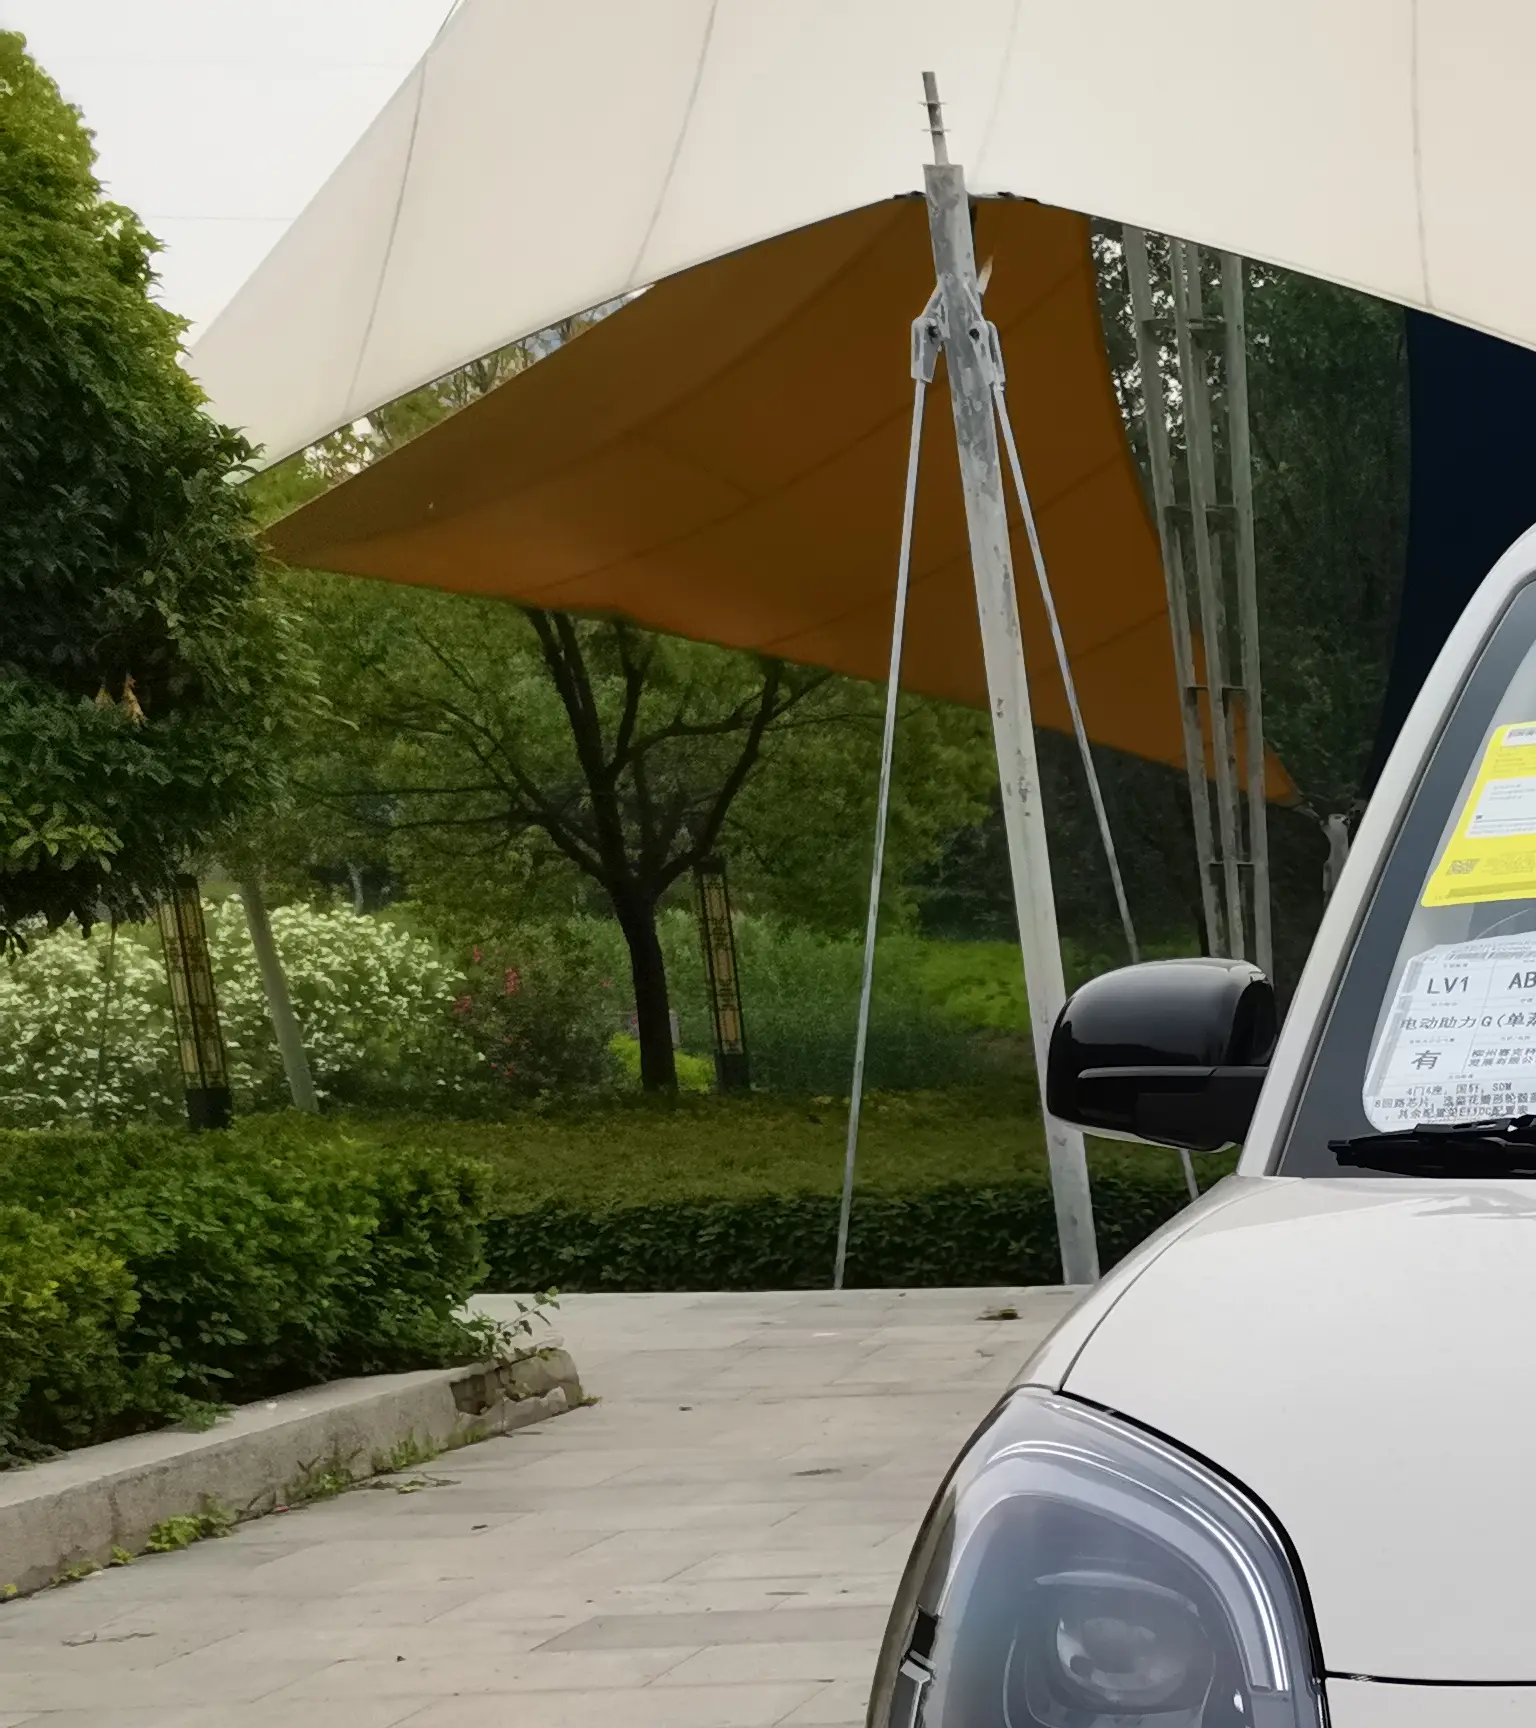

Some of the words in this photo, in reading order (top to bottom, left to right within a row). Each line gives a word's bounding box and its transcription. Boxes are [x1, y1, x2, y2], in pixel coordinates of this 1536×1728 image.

[1426, 976, 1470, 995] LV1
[1400, 1015, 1476, 1030] 电动助力
[1410, 1050, 1442, 1071] 有
